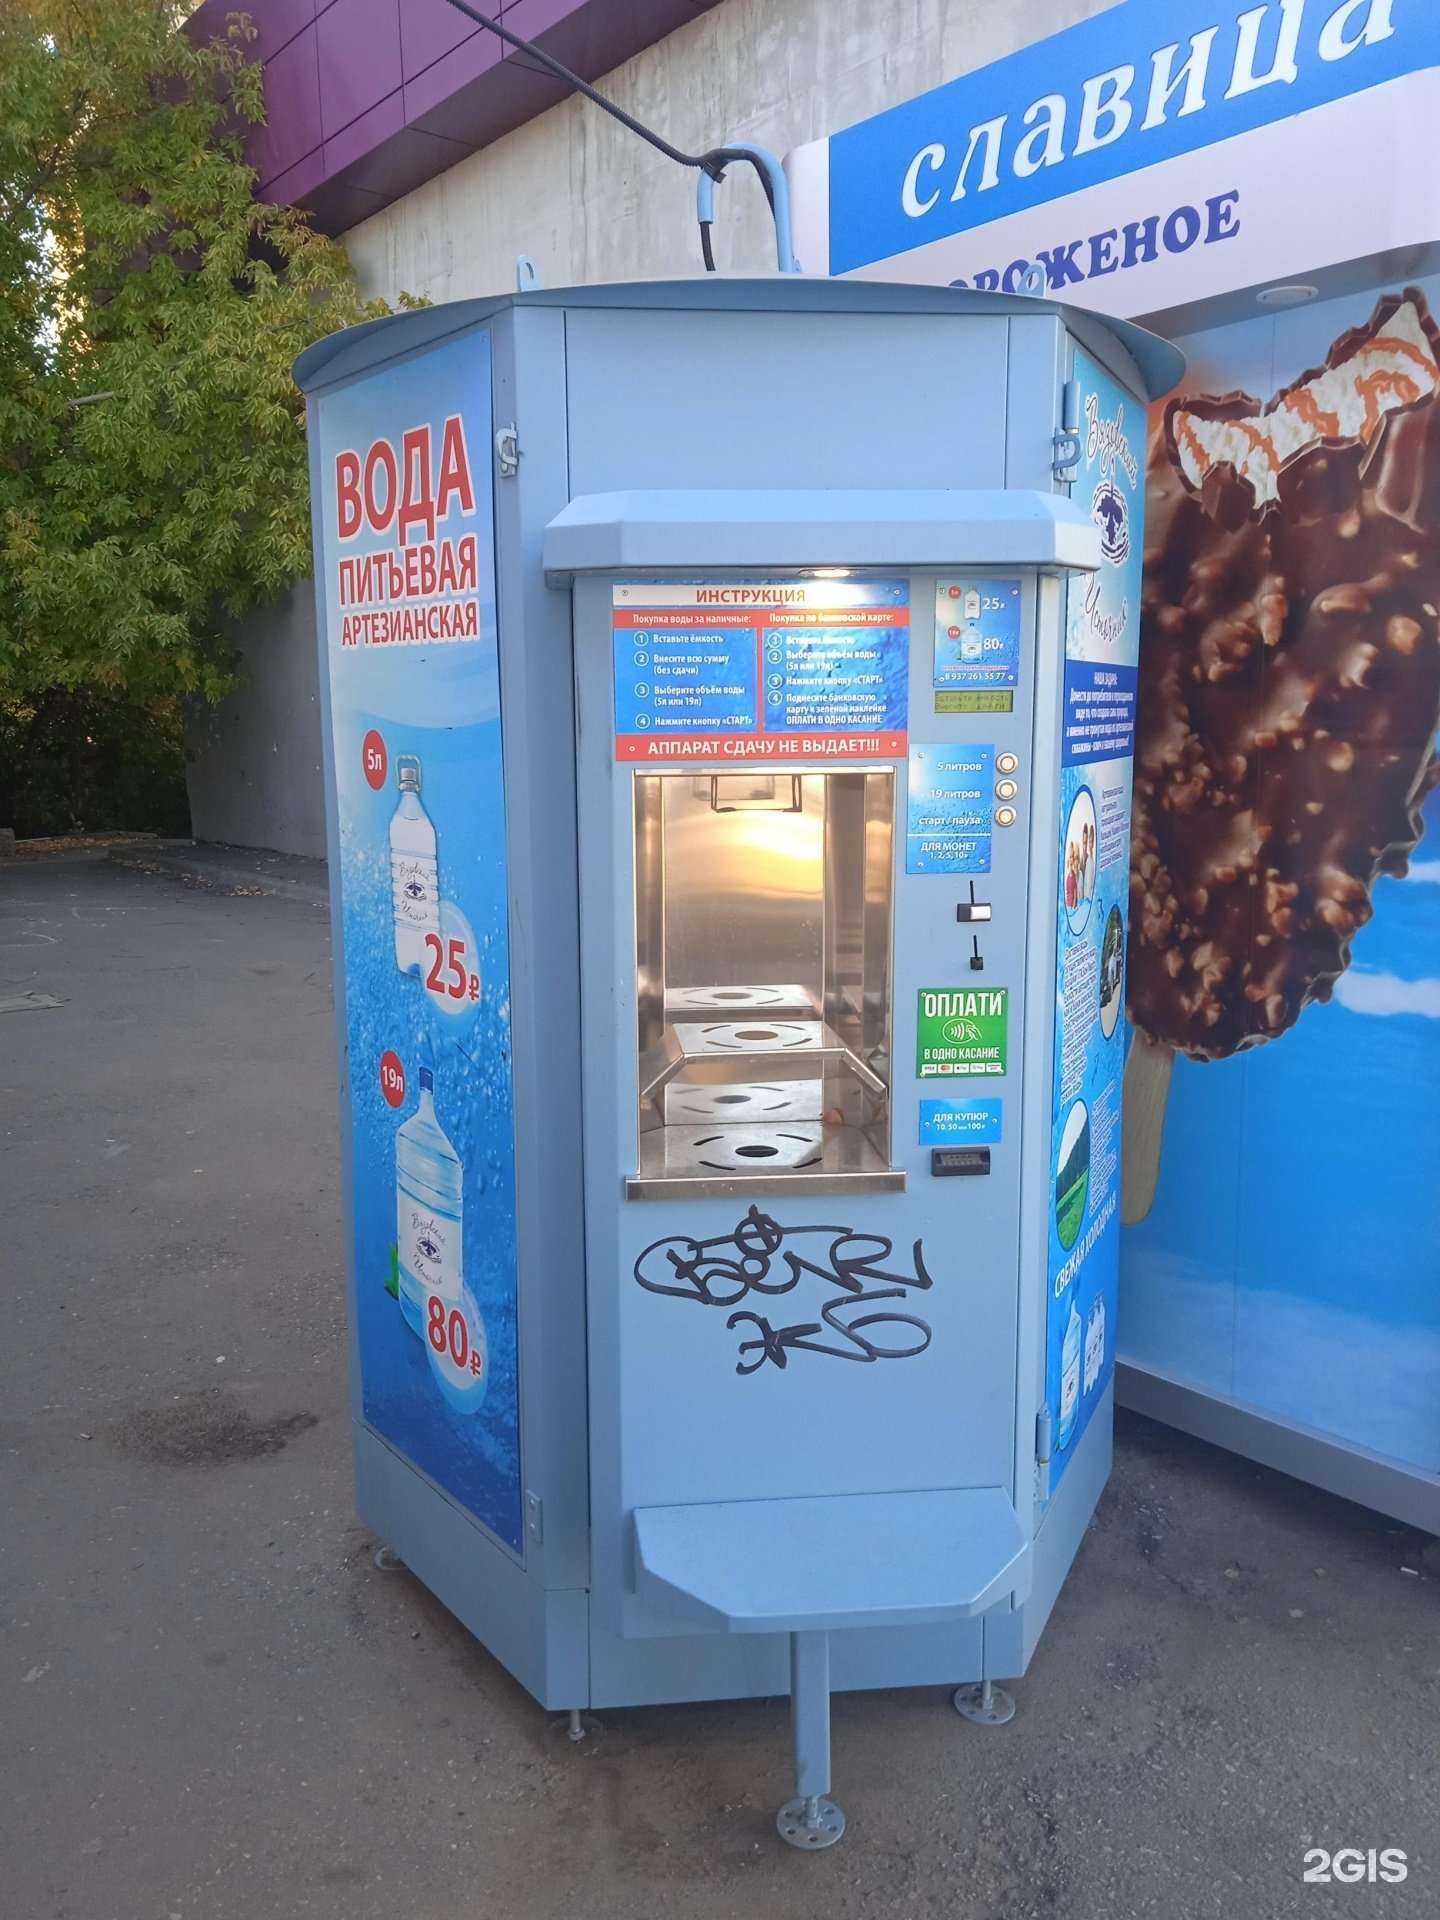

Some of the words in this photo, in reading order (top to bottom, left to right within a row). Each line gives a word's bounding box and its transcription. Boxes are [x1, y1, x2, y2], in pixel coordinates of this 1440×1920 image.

[902, 0, 1397, 218] славица
[949, 190, 1241, 294] РОЖЕНОЕ
[335, 416, 474, 546] ВОДА
[338, 536, 477, 606] ПИТЬЕВАЯ
[695, 589, 806, 606] ИНСТРУКЦИЯ
[341, 601, 478, 646] АРТЕЗИАНСКАЯ
[633, 613, 669, 627] Покупка
[671, 615, 693, 625] воды
[694, 616, 705, 624] за
[707, 614, 752, 624] наличные:
[769, 612, 805, 625] Покупка
[867, 613, 895, 624] карте:
[653, 634, 689, 643] Вставьте
[690, 634, 724, 643] ёмкость
[653, 654, 686, 663] Внесите
[703, 655, 730, 665] сумму
[853, 651, 877, 660] воды
[653, 666, 671, 676] (без
[672, 666, 699, 676] сдачи)
[654, 685, 694, 695] Выберите
[695, 685, 722, 694] объём
[723, 686, 745, 695] воды
[654, 697, 667, 707] (5л
[685, 697, 702, 707] 19л)
[786, 694, 827, 703] Поднесите
[827, 692, 876, 702] банковскую
[786, 705, 809, 714] карту
[654, 717, 691, 725] Нажмите
[692, 718, 721, 727] кнопку
[722, 716, 753, 725] «СТАРТ»
[786, 715, 817, 724] ОПЛАТИ
[818, 715, 824, 723] В
[825, 714, 847, 725] ОДНО
[847, 714, 882, 723] КАСАНИЕ
[648, 741, 721, 755] АППАРАТ
[723, 741, 775, 757] СДАЧУ
[779, 740, 799, 754] НЕ
[802, 739, 880, 756] ВЫДАЕТ!!!
[367, 748, 382, 770] 5л
[937, 761, 944, 770] 5
[945, 763, 982, 772] литров
[930, 789, 943, 798] 19
[944, 790, 981, 799] литров
[919, 817, 944, 826] старт
[951, 817, 981, 826] пауза
[921, 842, 941, 852] ДЛЯ
[942, 842, 976, 851] МОНЕТ
[924, 992, 1002, 1018] ОПЛАТИ
[924, 1048, 931, 1060] В
[932, 1047, 957, 1061] ОДНО
[958, 1046, 1000, 1060] КАСАНИЕ
[382, 1065, 405, 1092] 19л
[933, 1113, 953, 1122] ДЛЯ
[955, 1112, 989, 1121] КУПЮР
[1054, 1237, 1086, 1298] СВЕЖАЯ
